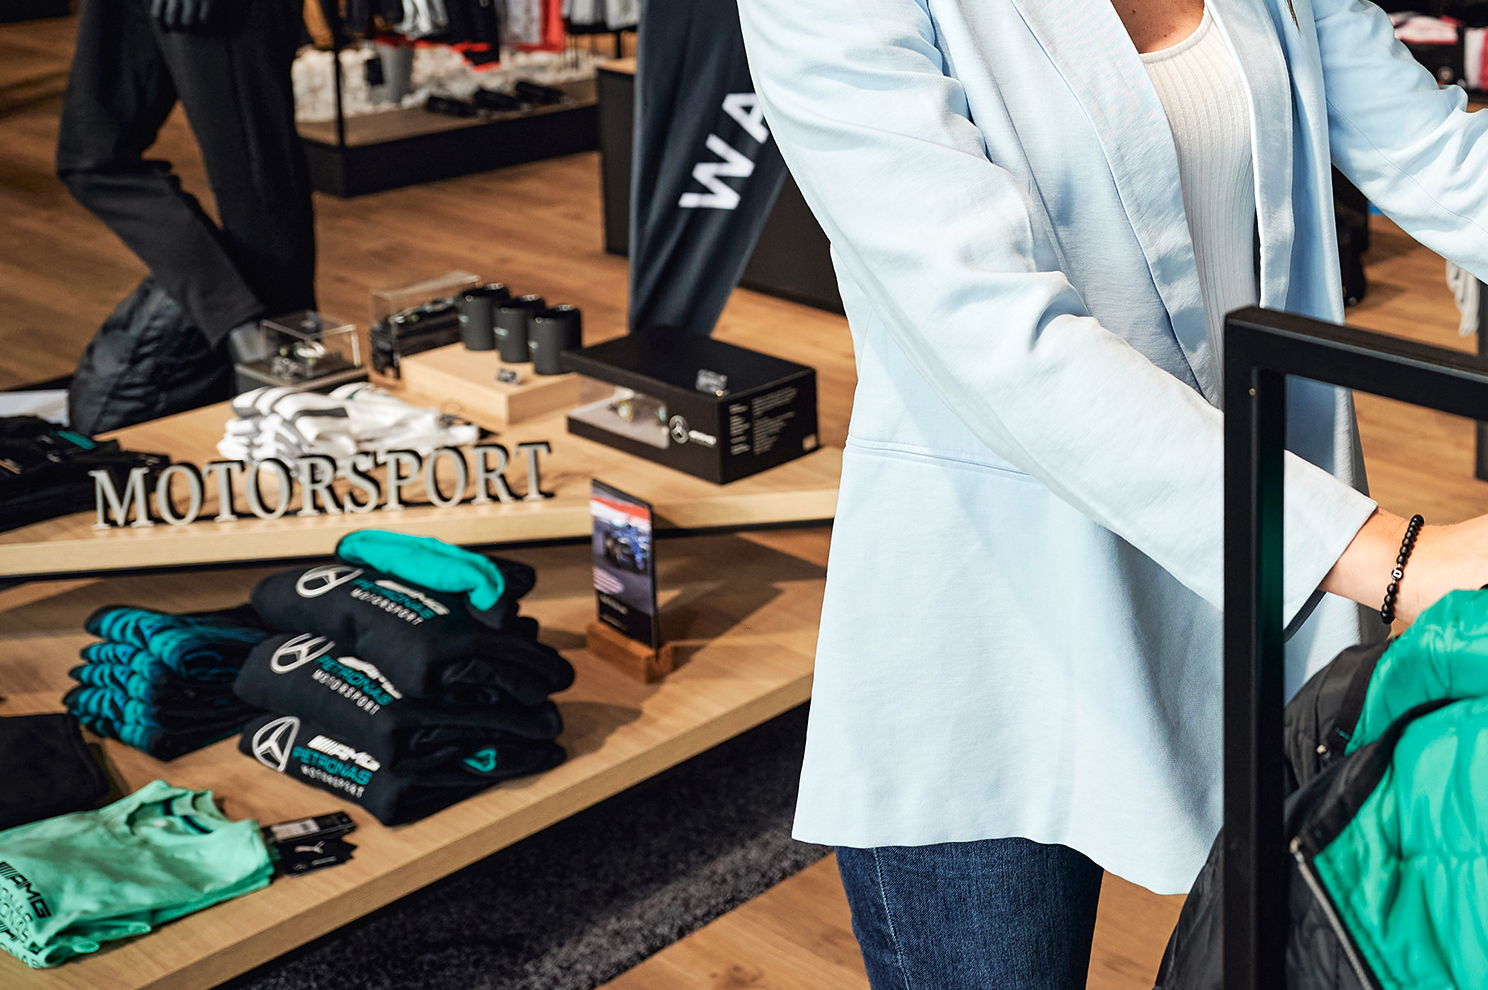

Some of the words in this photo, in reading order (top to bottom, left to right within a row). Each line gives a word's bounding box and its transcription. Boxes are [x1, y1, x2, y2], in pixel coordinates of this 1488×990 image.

[678, 92, 769, 210] WA
[88, 441, 553, 531] MOTORSPORT
[349, 587, 424, 626] MOTORSPORT
[311, 668, 381, 716] MOTORSPORT
[315, 654, 394, 706] PETRONAS
[291, 745, 372, 786] PETRONAS
[322, 739, 381, 772] AMG
[8, 872, 51, 919] AMG
